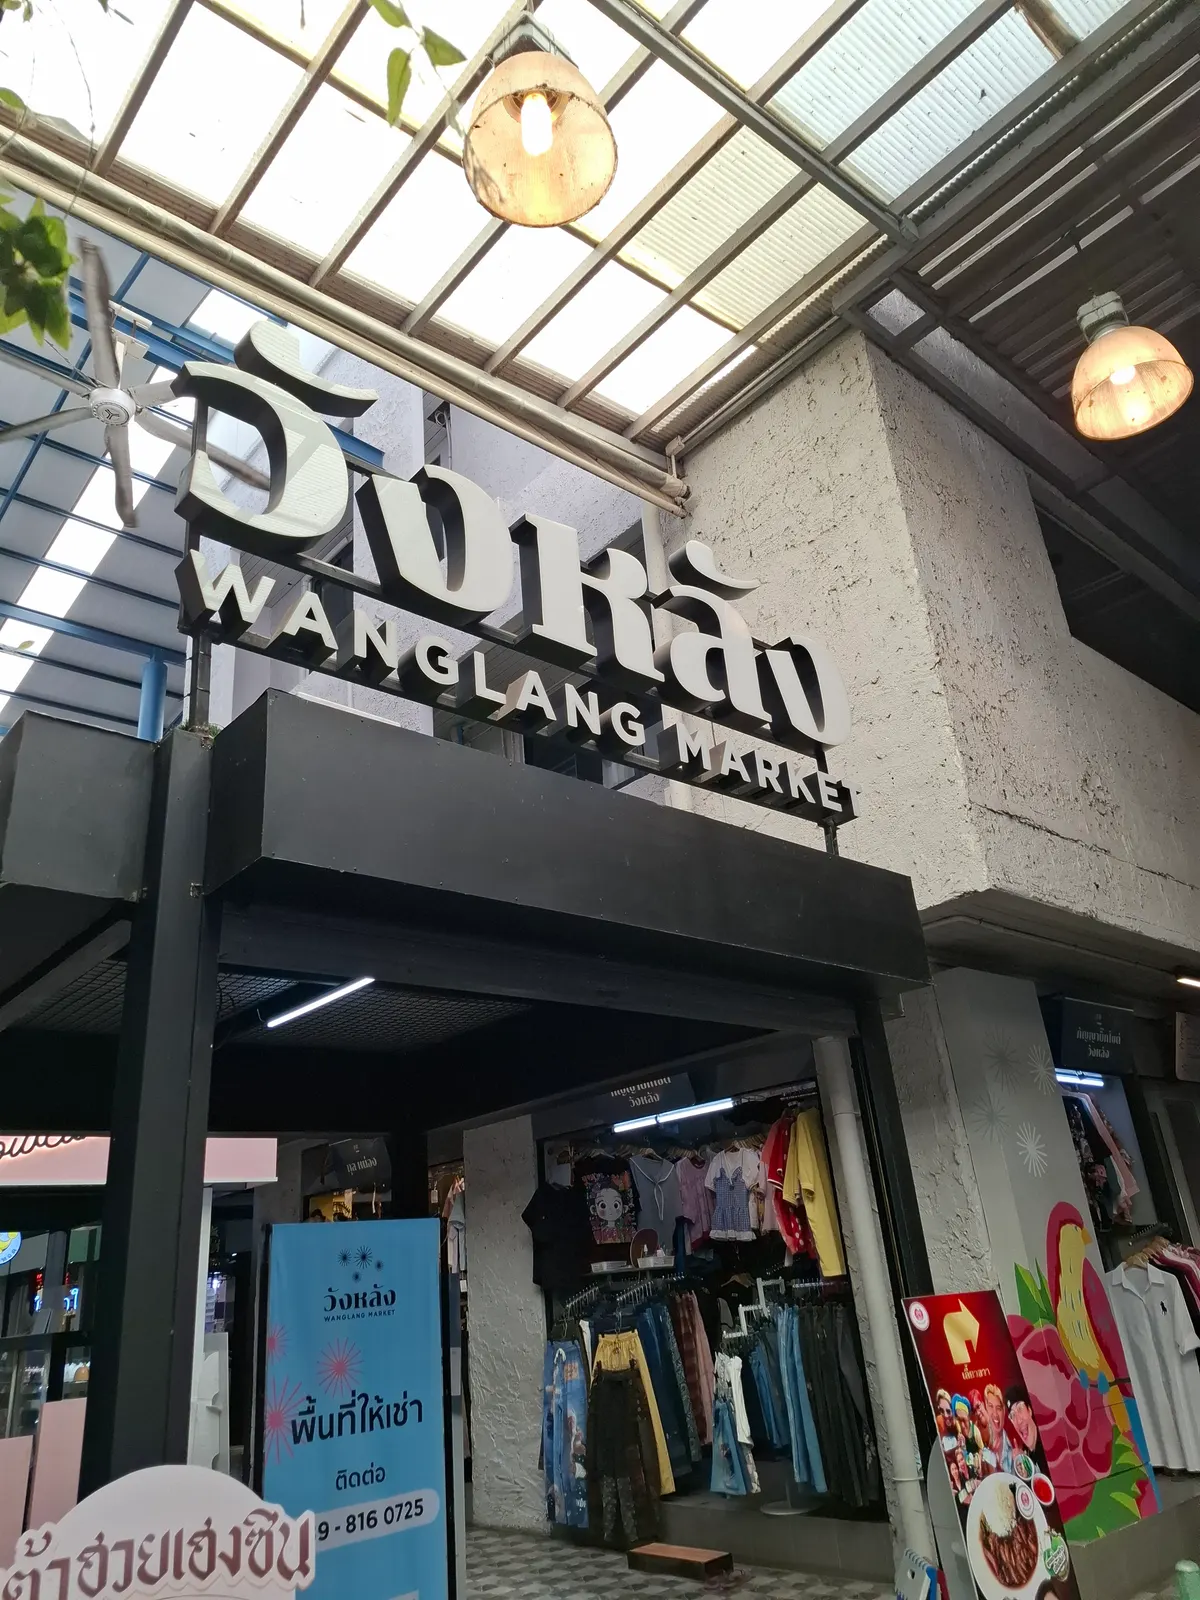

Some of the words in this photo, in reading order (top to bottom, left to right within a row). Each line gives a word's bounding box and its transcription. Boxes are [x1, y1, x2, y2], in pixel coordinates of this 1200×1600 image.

[174, 321, 851, 750] วังหลัง
[190, 549, 646, 747] WANGLANG
[678, 720, 862, 817] MARKET
[628, 1091, 660, 1108] วังหลัง
[324, 1283, 397, 1312] วังหลัง
[324, 1312, 366, 1322] WANGLANG
[368, 1309, 396, 1318] MARKET
[291, 1390, 423, 1445] พื้นที่ให้เช่า
[335, 1462, 386, 1490] ติดต่อ
[346, 1510, 378, 1534] 816
[384, 1497, 424, 1525] 0725
